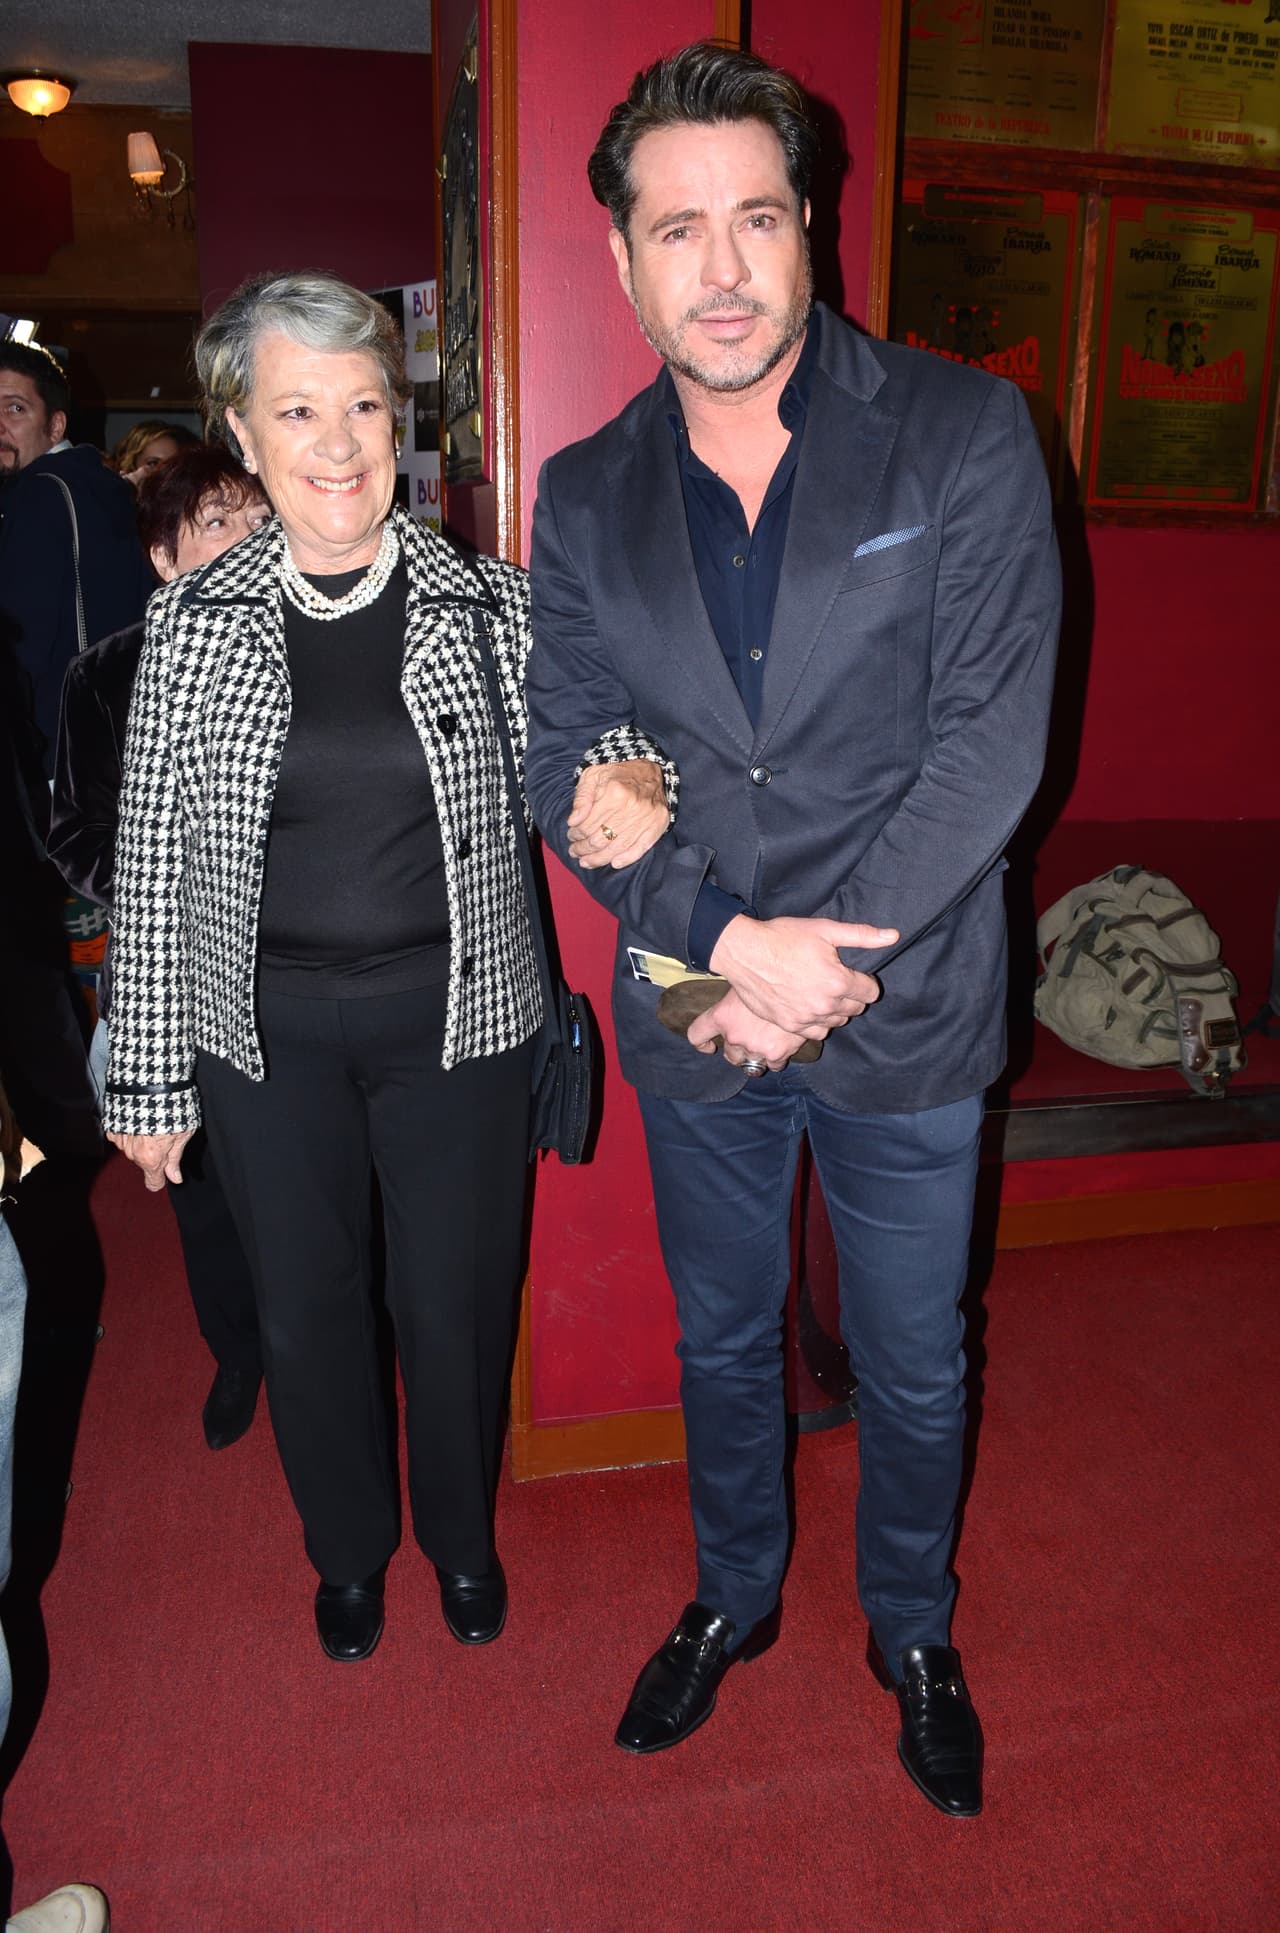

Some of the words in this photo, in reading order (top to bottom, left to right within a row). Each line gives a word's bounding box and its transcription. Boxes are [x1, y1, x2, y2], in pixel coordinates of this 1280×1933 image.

[1002, 237, 1053, 255] IBARRA
[1214, 254, 1260, 272] IBARRA
[1194, 349, 1246, 390] SEXO
